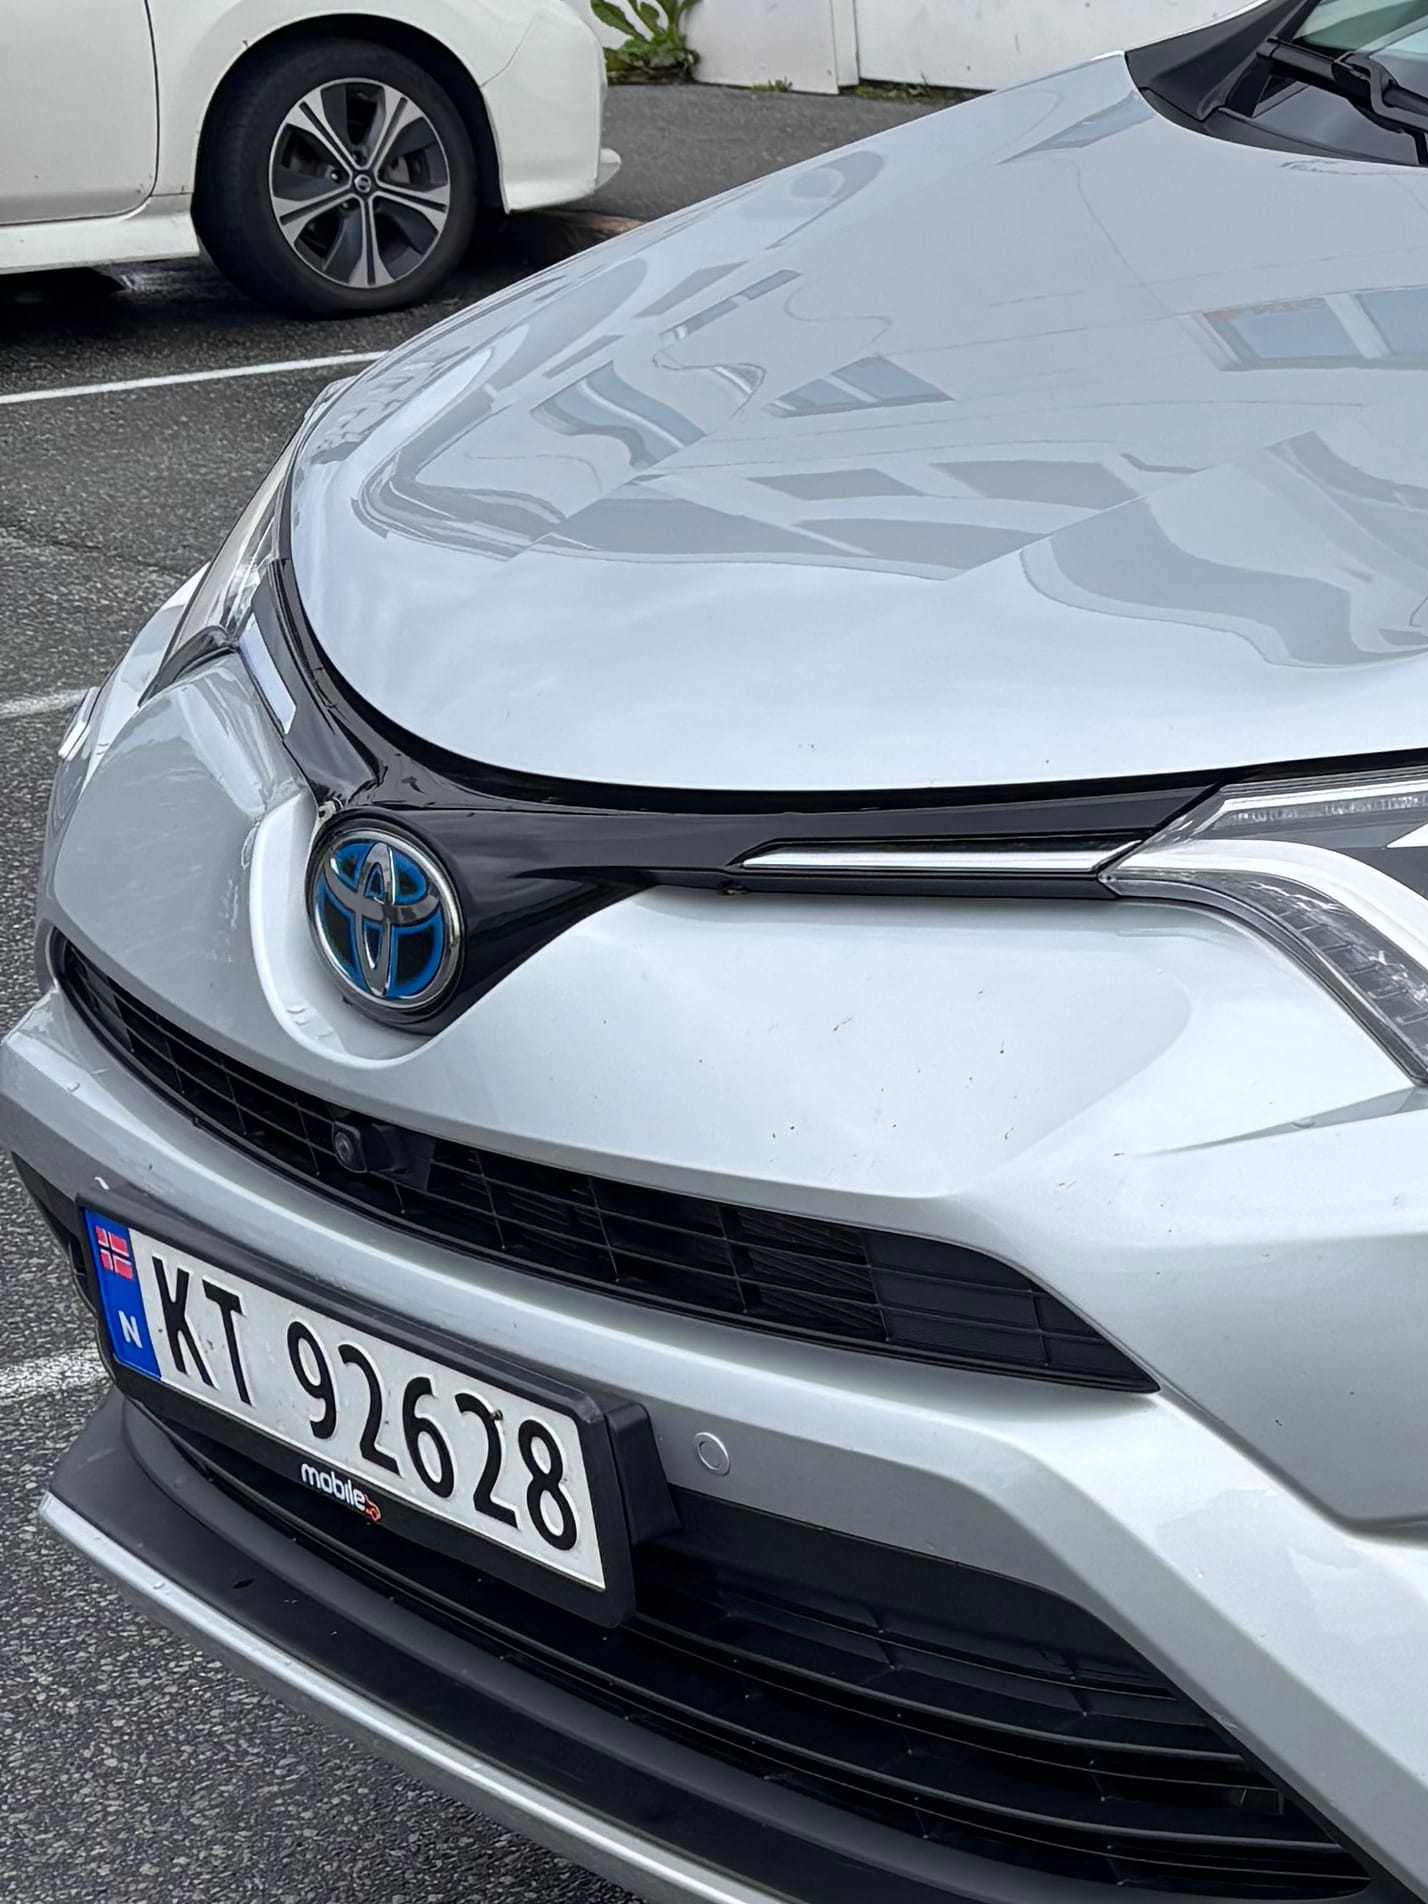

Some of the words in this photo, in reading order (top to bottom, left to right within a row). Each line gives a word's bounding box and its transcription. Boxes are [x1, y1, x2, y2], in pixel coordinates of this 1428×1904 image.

[120, 1310, 143, 1351] N
[153, 1256, 252, 1407] KT
[287, 1321, 579, 1552] 92628
